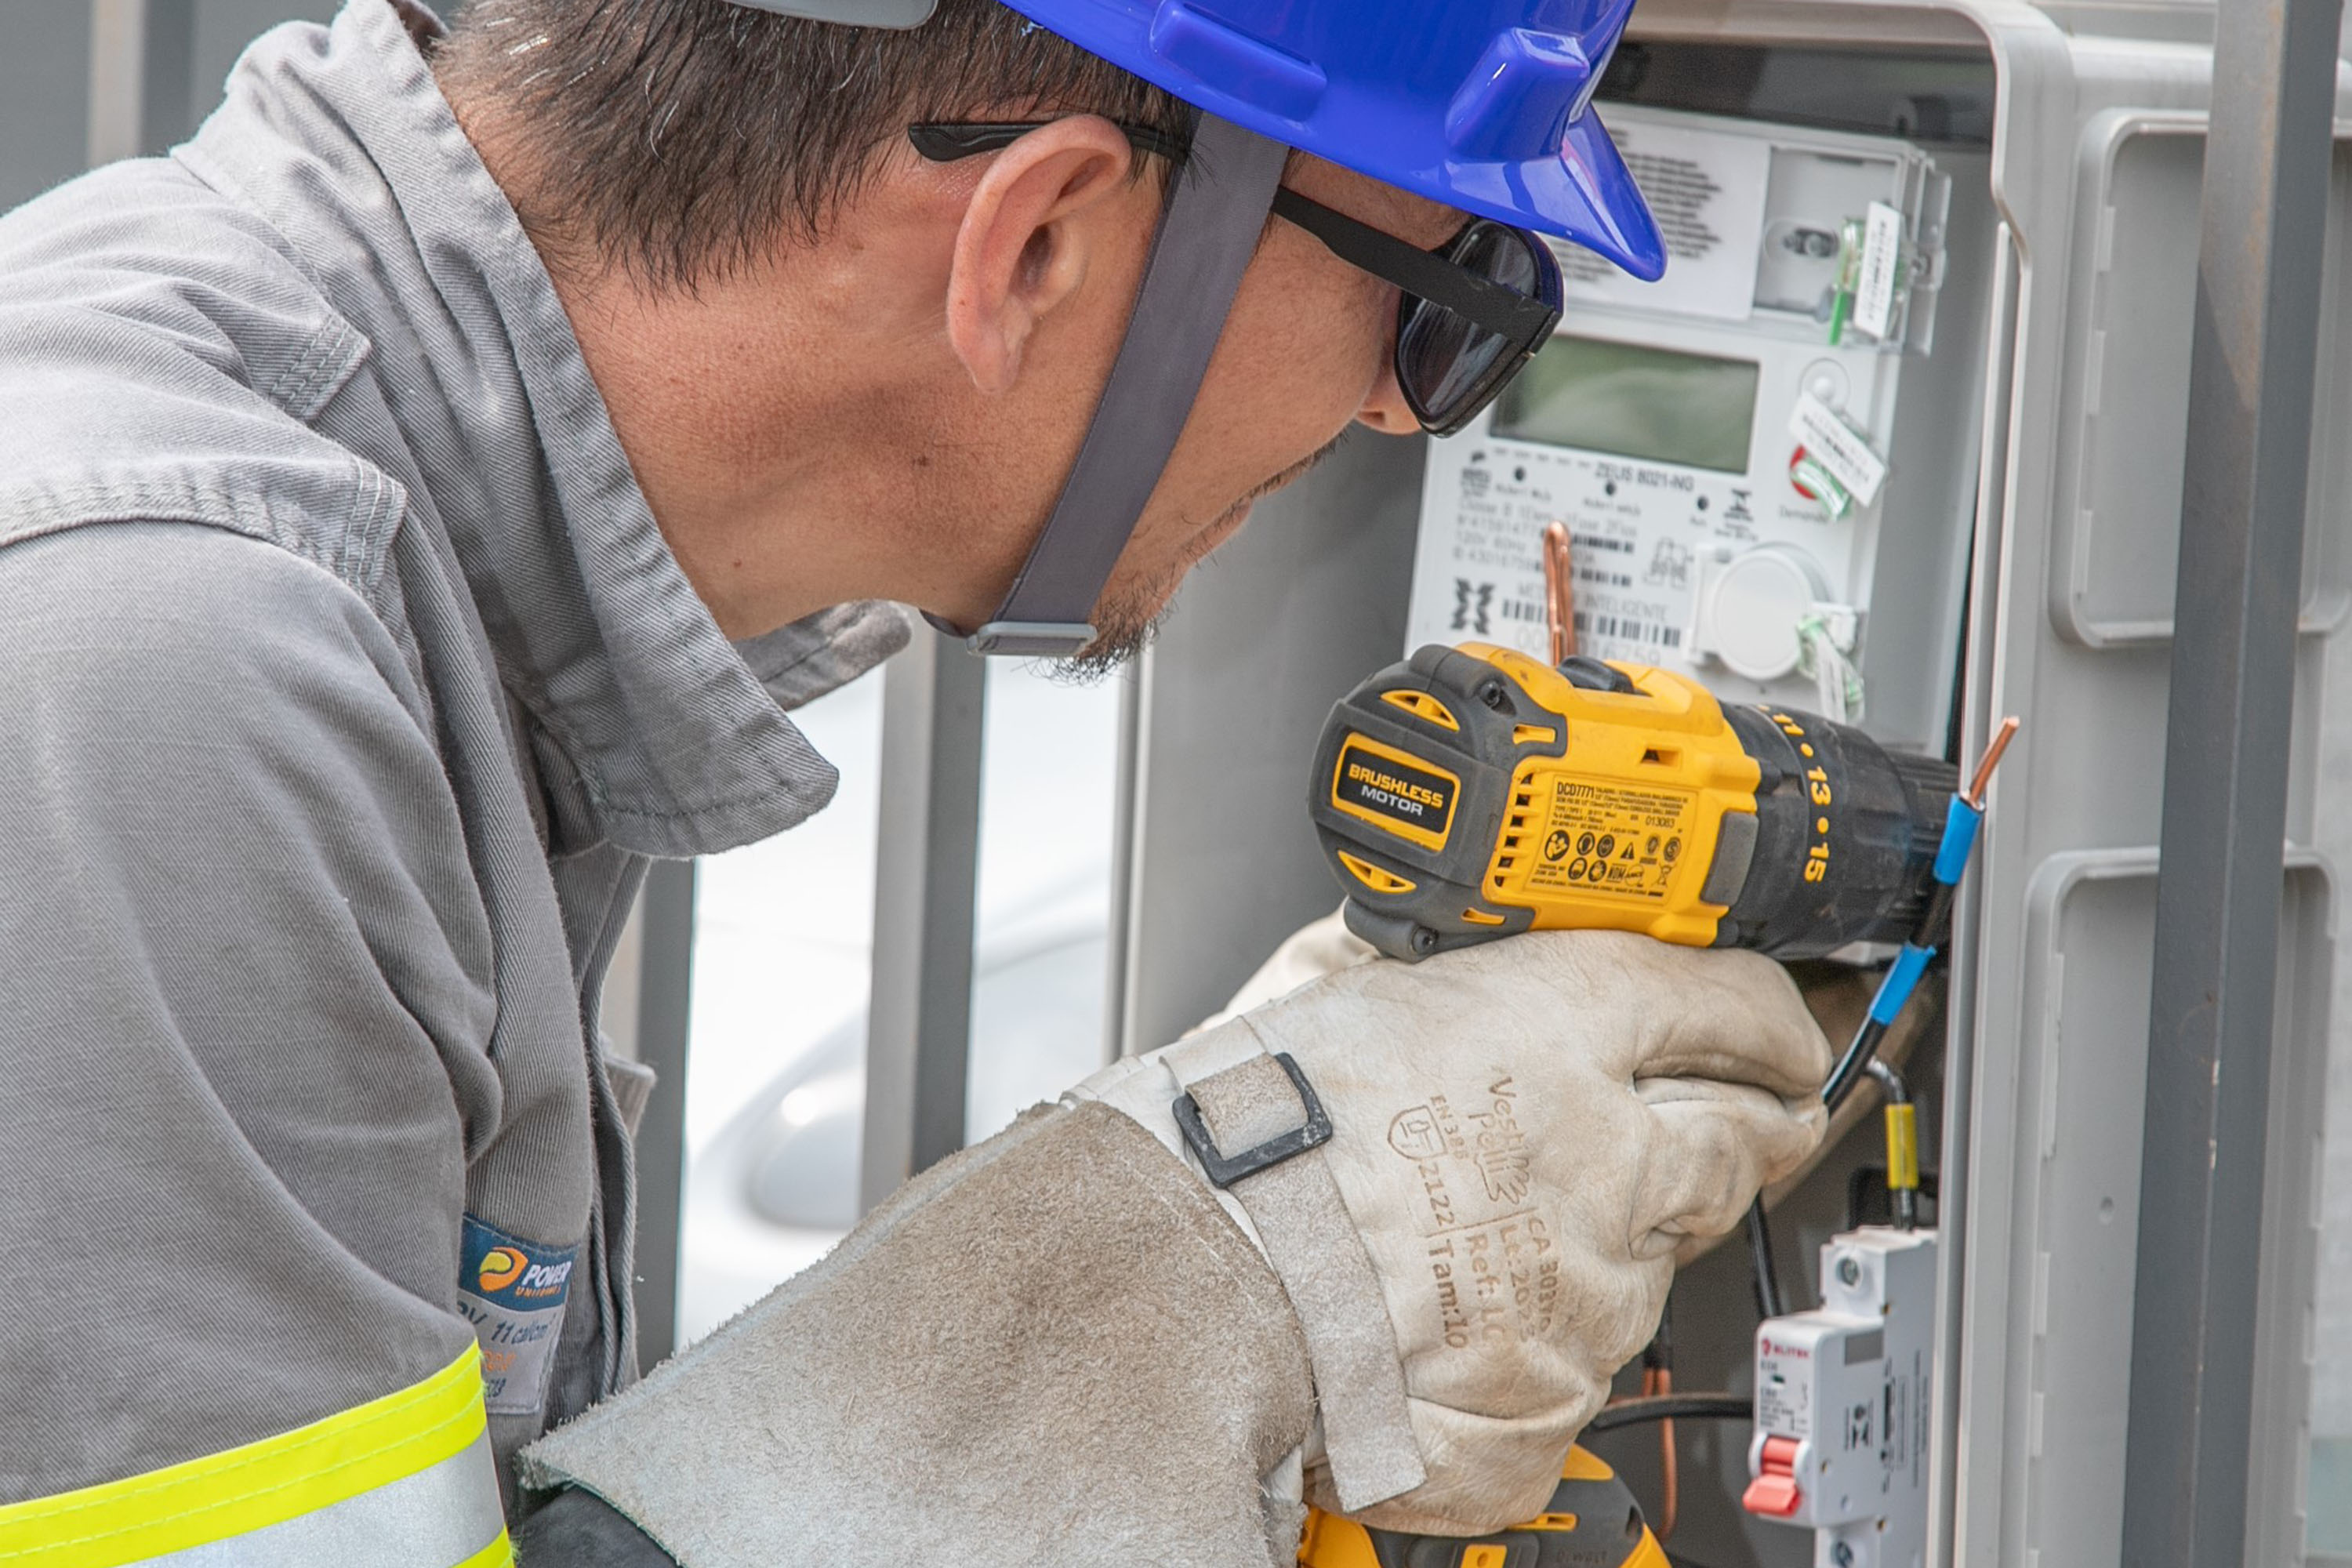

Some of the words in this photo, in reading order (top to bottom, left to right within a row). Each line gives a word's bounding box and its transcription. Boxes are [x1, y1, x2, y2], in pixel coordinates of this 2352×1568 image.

[1773, 713, 1805, 736] 11
[1348, 763, 1444, 809] BRUSHLESS
[1361, 785, 1424, 817] MOTOR
[1556, 782, 1595, 798] DCD7771
[1807, 765, 1832, 806] 13
[1804, 841, 1830, 883] 15
[1417, 1163, 1456, 1227] 2122
[1529, 1218, 1552, 1254] CA
[521, 1261, 572, 1288] POWER
